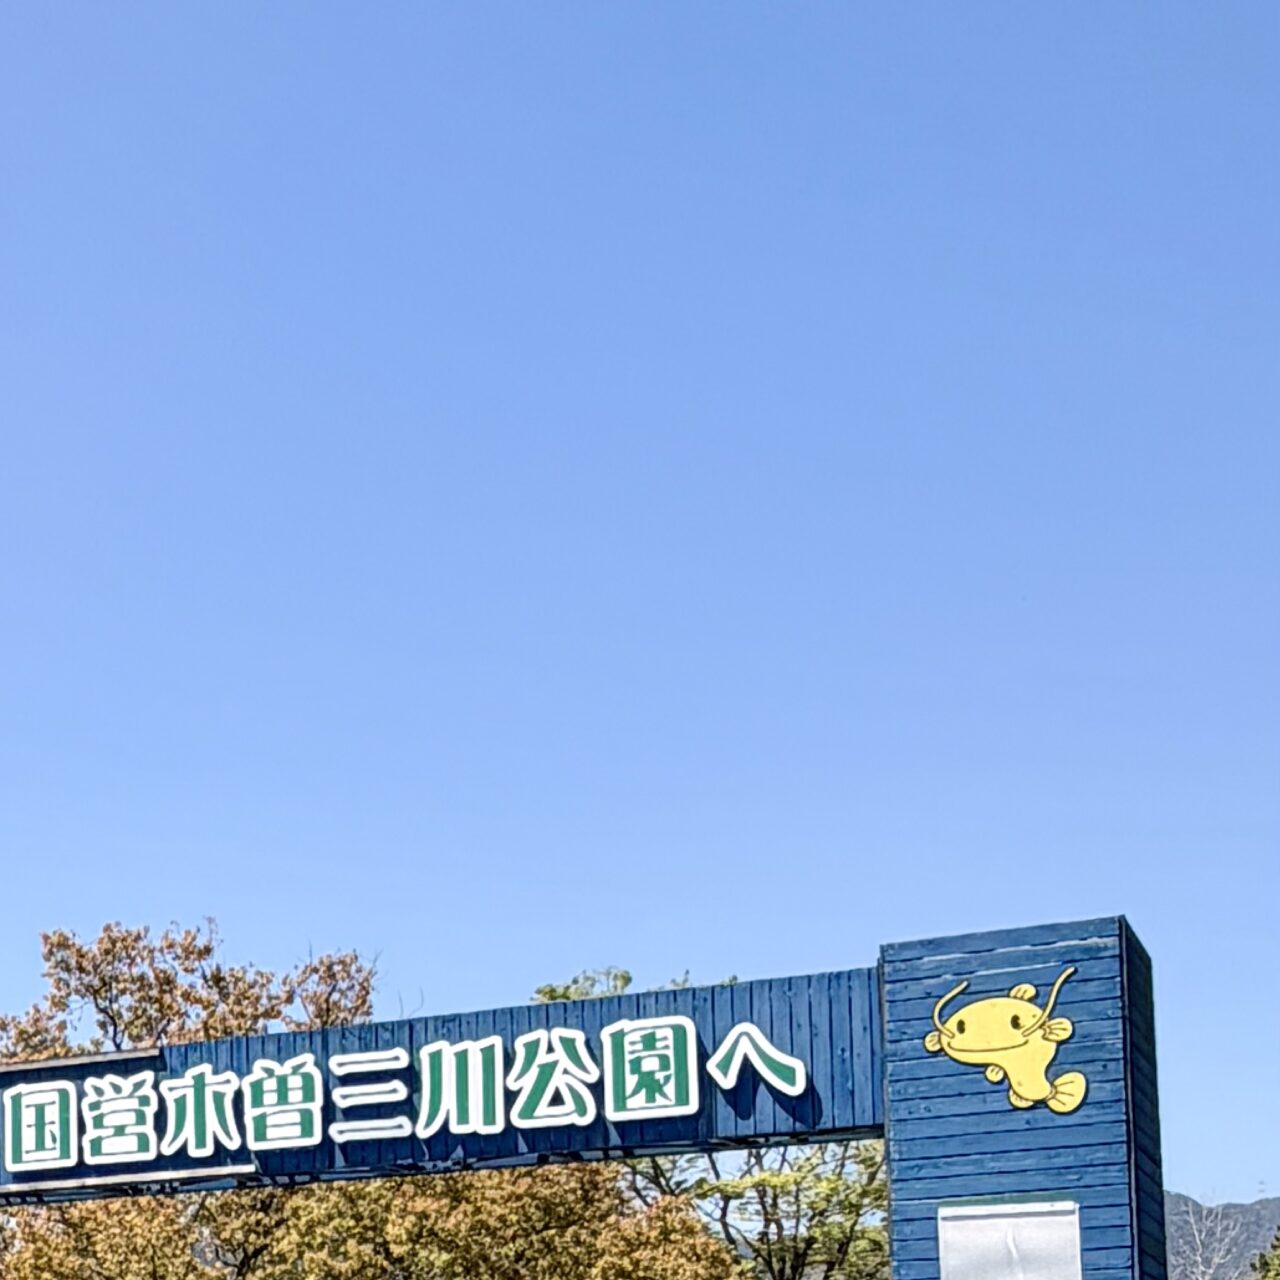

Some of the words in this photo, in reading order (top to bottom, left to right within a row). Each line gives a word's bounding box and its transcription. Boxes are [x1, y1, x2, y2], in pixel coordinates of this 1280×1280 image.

[3, 1015, 806, 1173] 国営木曽三川公園へ
